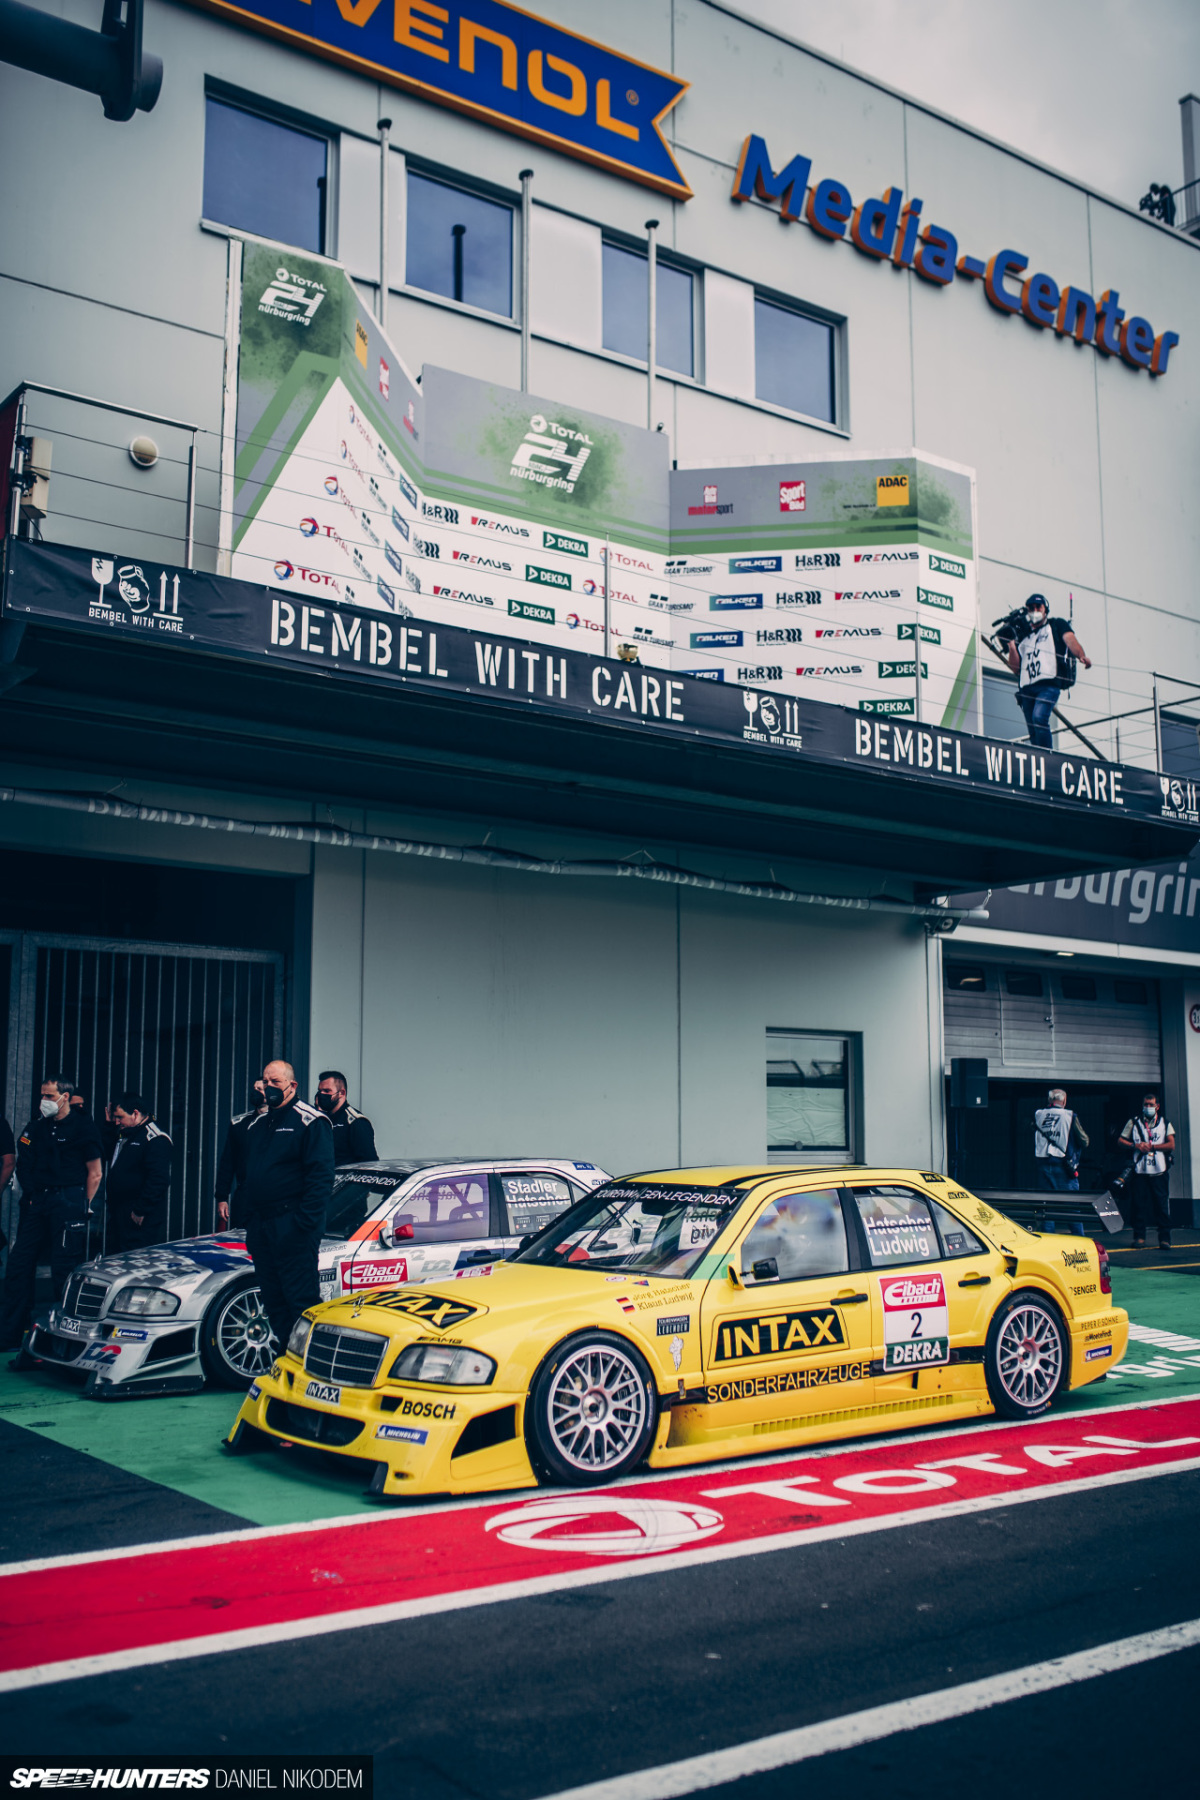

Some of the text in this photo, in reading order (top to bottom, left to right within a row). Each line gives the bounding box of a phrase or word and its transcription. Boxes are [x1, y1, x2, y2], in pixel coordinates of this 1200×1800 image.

[306, 0, 640, 141] VENOL
[731, 134, 1180, 376] Media-Center
[290, 273, 328, 293] TOTAL
[259, 280, 325, 317] 24
[258, 304, 312, 326] nürburgring
[548, 421, 594, 446] TOTAL
[511, 432, 591, 481] 24
[509, 467, 575, 494] nürburgring
[878, 476, 908, 488] ADAC
[780, 482, 805, 503] Sport
[477, 518, 530, 537] REMUS
[558, 539, 587, 554] DEKRA
[459, 552, 512, 571] REMUS
[615, 553, 654, 571] TOTAL
[735, 559, 777, 567] FALKEN
[795, 554, 823, 568] H&R
[860, 552, 919, 562] REMUS
[682, 566, 713, 574] TURISMO
[940, 561, 964, 576] DEKRA
[298, 567, 341, 594] TOTAL
[540, 571, 570, 587] DEKRA
[440, 587, 494, 606] REMUS
[715, 597, 757, 605] FALKEN
[775, 592, 804, 605] H&R
[842, 589, 901, 600] REMUS
[928, 593, 952, 608] DEKRA
[88, 607, 183, 633] BEMBEL WITH CARE
[523, 606, 553, 622] DEKRA
[696, 634, 738, 643] FALKEN
[756, 630, 784, 642] H&R
[823, 628, 882, 637] REMUS
[919, 628, 940, 642] EKRA
[270, 599, 684, 721] BEMBEL WITH CARE
[737, 667, 764, 680] H&R
[804, 666, 862, 675] REMUS
[1026, 660, 1041, 680] 132
[877, 702, 911, 713] DEKRA
[743, 730, 802, 748] BEMBEL WITH CARE
[855, 718, 1124, 805] BEMBEL WITH CARE
[507, 1181, 557, 1194] Stadler
[506, 1194, 570, 1208] Hatscher
[863, 1214, 932, 1236] Hatscher
[869, 1233, 930, 1257] Ludwig
[343, 1262, 404, 1285] Eibach
[1076, 1265, 1092, 1274] RACING
[884, 1277, 941, 1307] Eibach
[1073, 1284, 1097, 1296] SENGER
[637, 1291, 695, 1311] Klaus Ludwig
[910, 1311, 923, 1338] 2
[1081, 1320, 1097, 1331] PEPER
[1102, 1315, 1119, 1327] SÖHNE
[722, 1314, 838, 1359] INTAX
[81, 1341, 122, 1365] D2
[892, 1340, 943, 1364] DEKRA
[308, 1382, 338, 1401] INTAX
[707, 1361, 871, 1404] SONDERFAHRZEUGE
[402, 1400, 457, 1420] BOSCH
[386, 1428, 421, 1440] MICHELIN
[699, 1436, 1200, 1507] TOTAL
